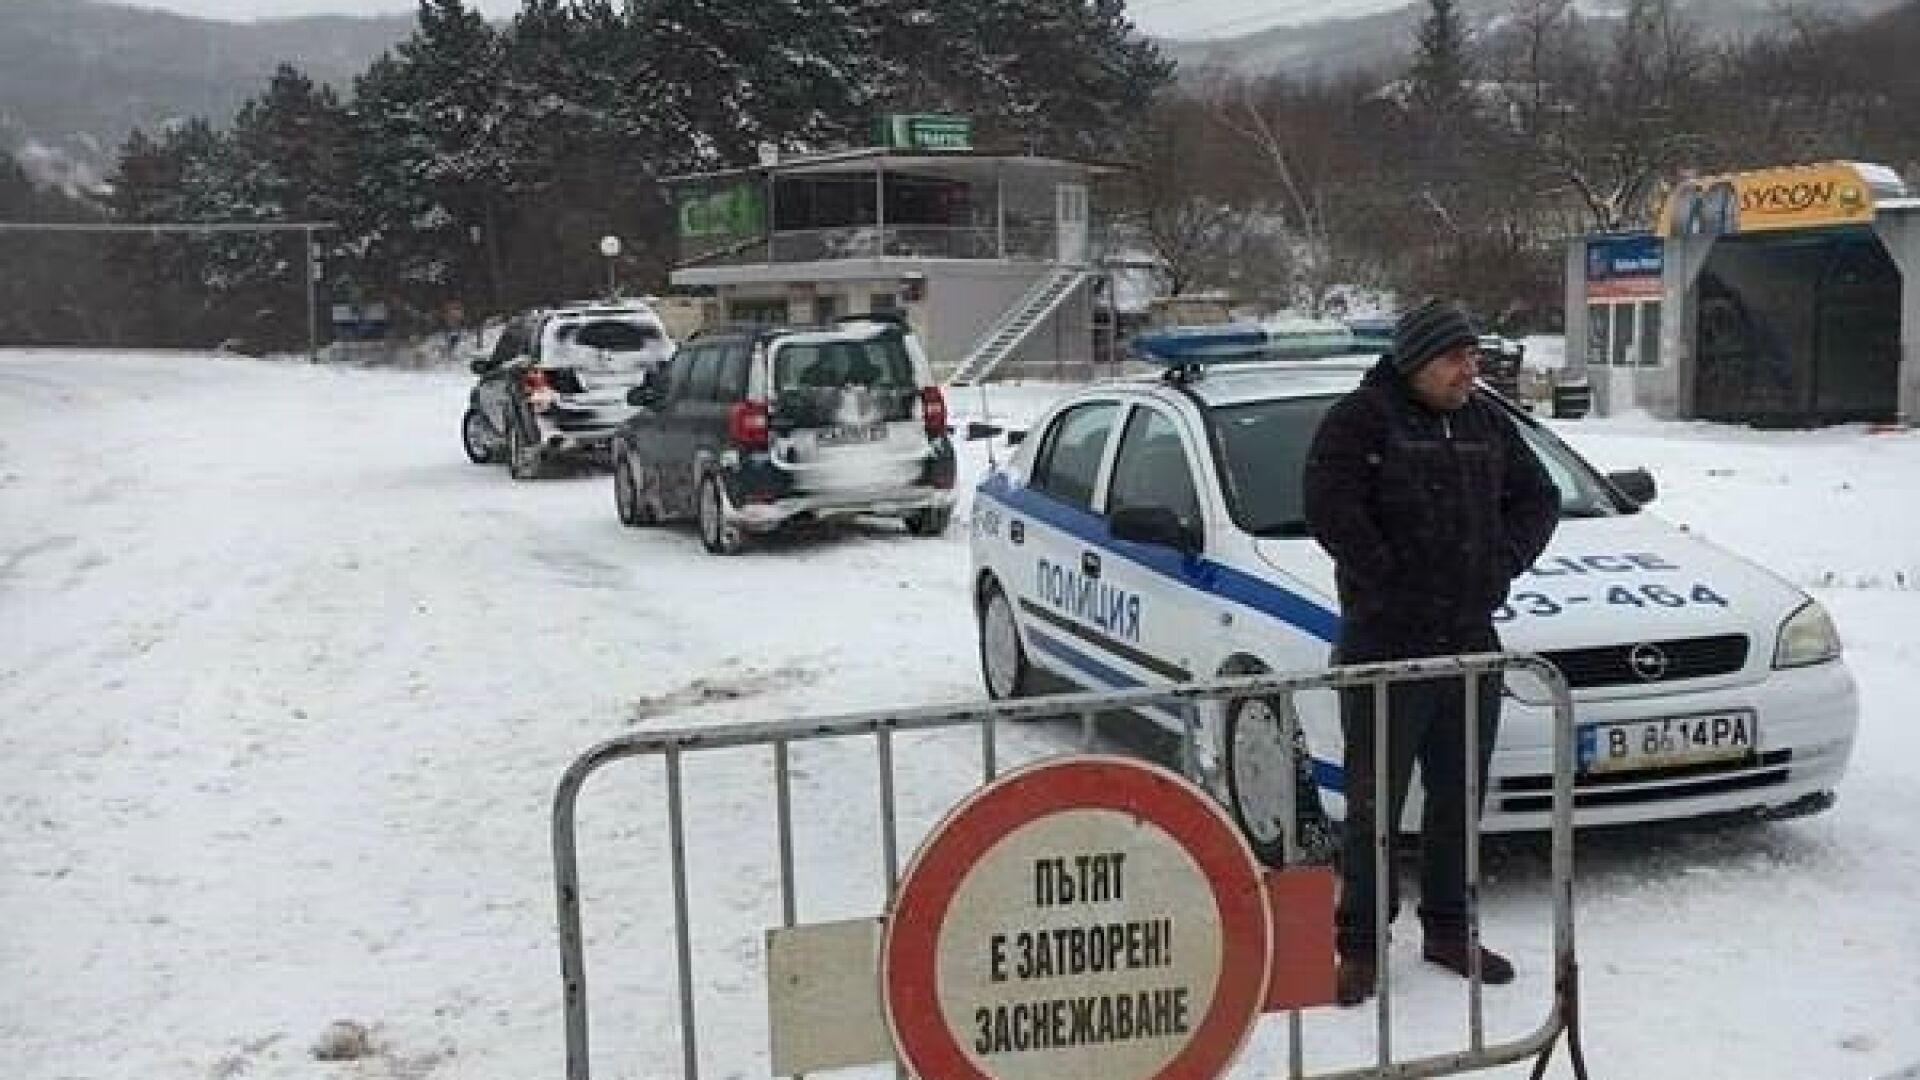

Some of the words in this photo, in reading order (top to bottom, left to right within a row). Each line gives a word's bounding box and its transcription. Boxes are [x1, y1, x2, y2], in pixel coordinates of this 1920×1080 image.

[1036, 558, 1140, 643] ПОЛИЦИЯ
[1609, 728, 1628, 758] B
[1034, 852, 1127, 906] ПЪТЯТ
[990, 935, 1008, 983] Е
[1016, 918, 1173, 980] ЗАТВОРЕН!
[974, 986, 1190, 1055] ЗАСНЕЖАВАНЕ
